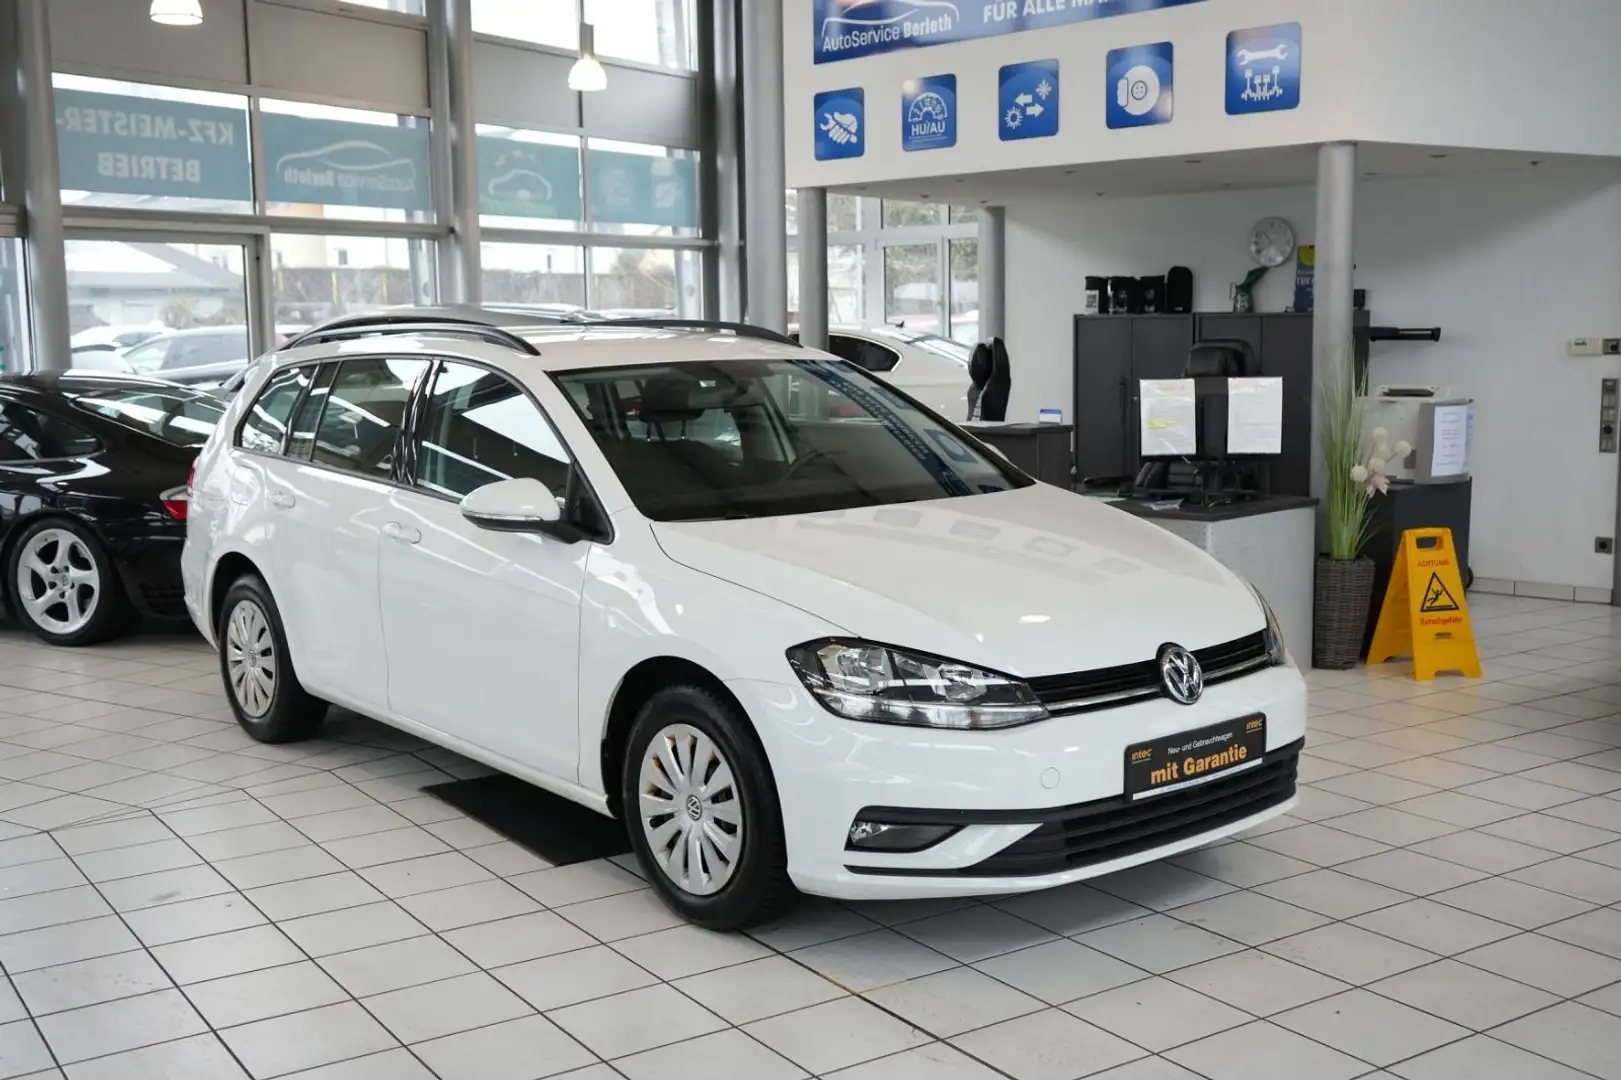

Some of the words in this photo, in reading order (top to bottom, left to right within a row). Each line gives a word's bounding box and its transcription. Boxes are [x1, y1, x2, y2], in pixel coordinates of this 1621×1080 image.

[984, 0, 1018, 23] FÜR
[1022, 0, 1066, 17] ALLE
[823, 24, 900, 52] AutoService
[903, 13, 952, 38] Berleth
[912, 120, 946, 137] HU/AU
[1181, 741, 1192, 751] und
[1192, 732, 1233, 749] Gebrauchtwagen
[1151, 762, 1179, 784] mit
[1183, 744, 1248, 775] Garantie
